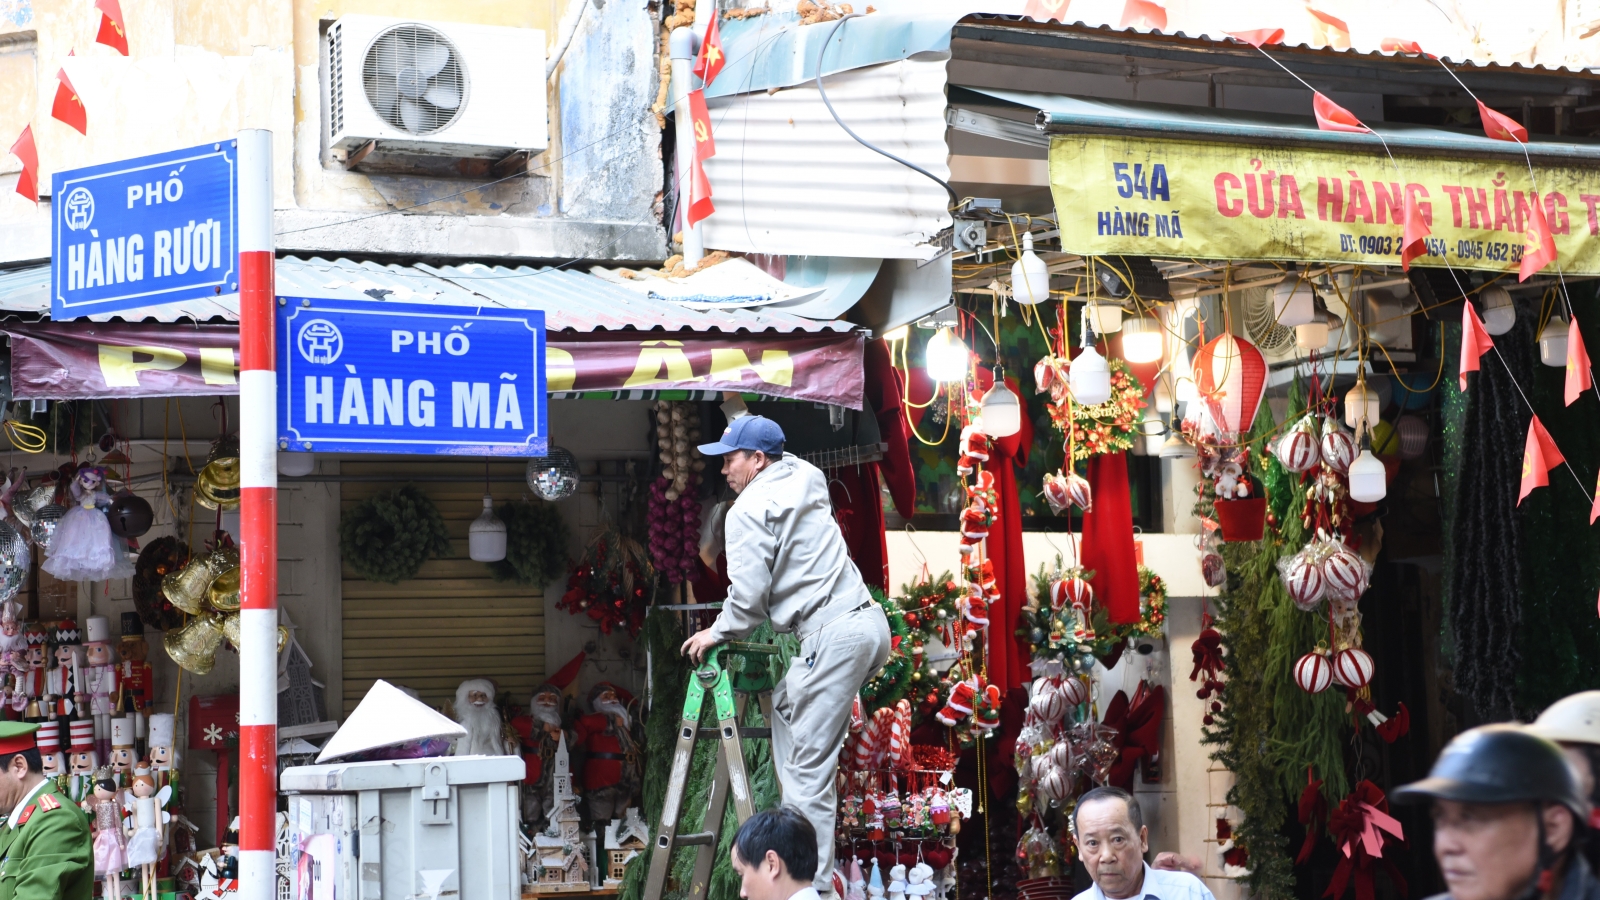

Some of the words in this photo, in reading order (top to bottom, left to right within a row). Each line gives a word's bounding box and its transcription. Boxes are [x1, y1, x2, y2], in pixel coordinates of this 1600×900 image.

[127, 164, 187, 209] PHỐ
[1113, 162, 1170, 201] 54A
[1213, 158, 1306, 219] CỬA
[1317, 170, 1433, 227] HÀNG
[1442, 171, 1570, 235] THẮNG
[1097, 206, 1150, 237] HÀNG
[1155, 209, 1183, 239] MÃ
[68, 229, 144, 291] HÀNG
[153, 218, 221, 278] RƯƠI
[1359, 235, 1392, 255] 0903
[1457, 239, 1483, 260] 0945
[1486, 241, 1508, 262] 452
[391, 322, 474, 356] PHỐ
[304, 364, 436, 427] HÀNG
[451, 372, 524, 430] MÃ
